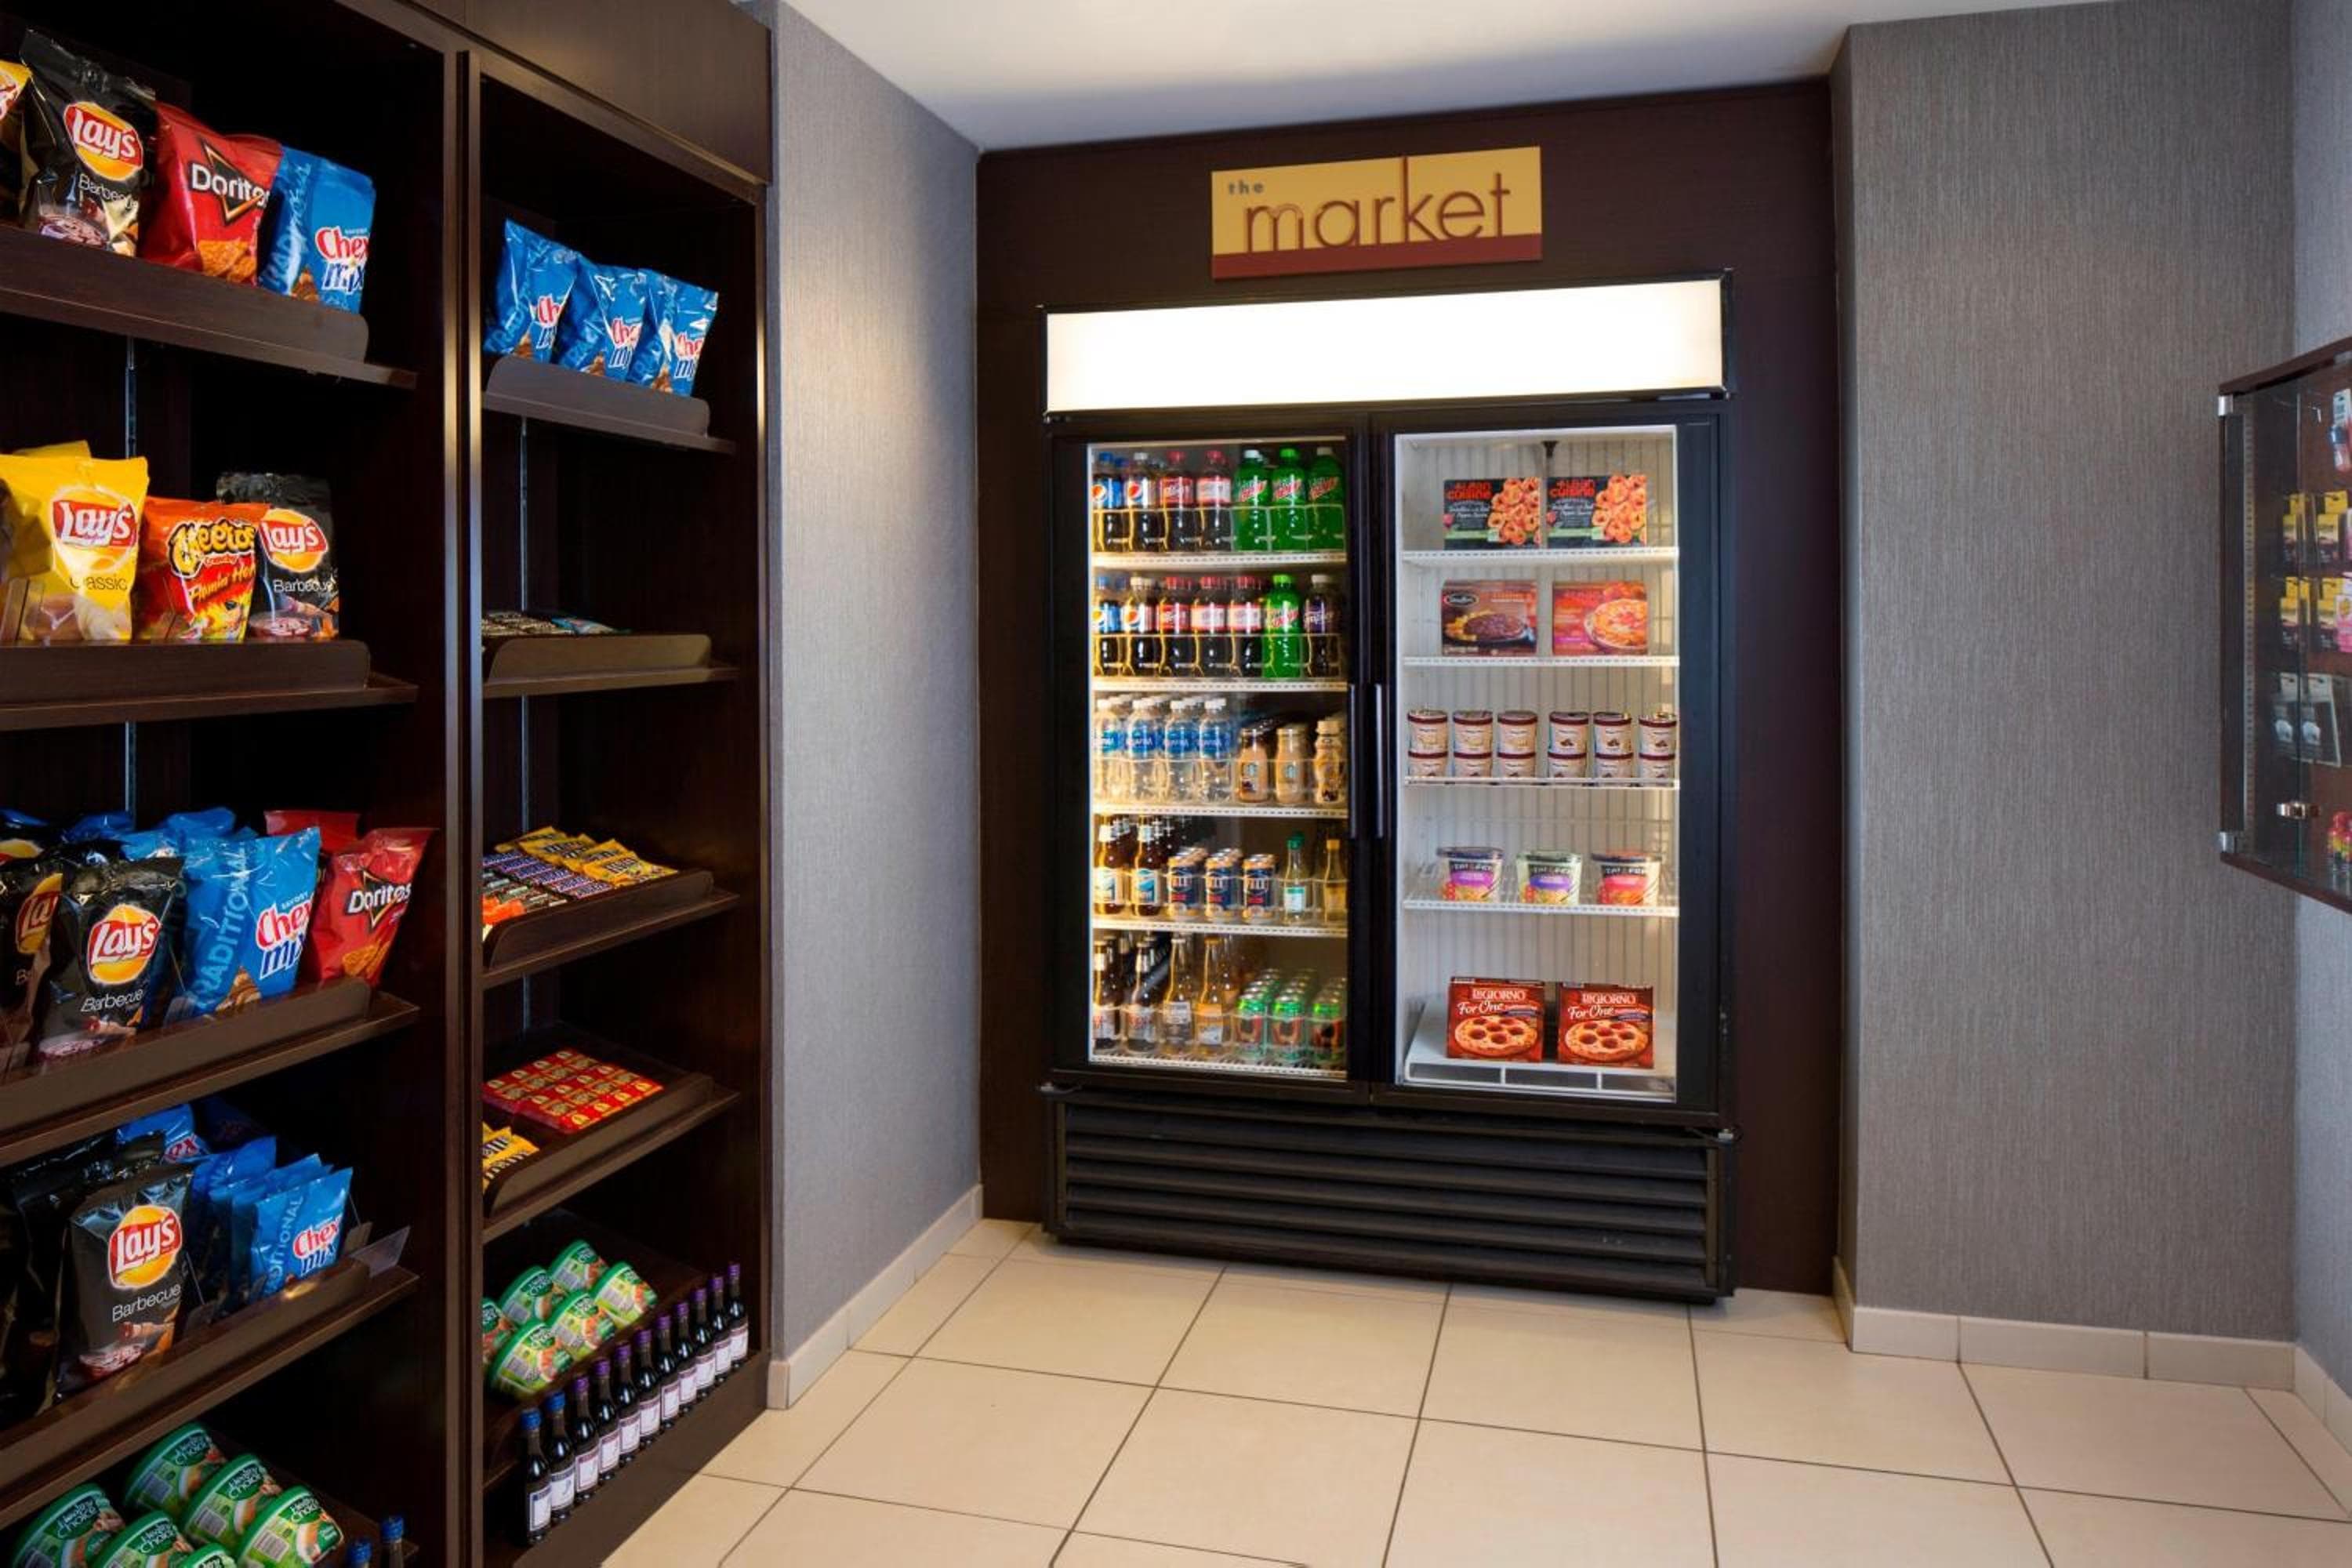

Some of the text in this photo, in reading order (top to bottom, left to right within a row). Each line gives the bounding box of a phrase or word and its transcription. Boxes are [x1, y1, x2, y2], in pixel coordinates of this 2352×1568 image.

[73, 109, 136, 160] Lay's
[1229, 180, 1265, 195] the
[1246, 157, 1511, 253] market
[59, 499, 132, 546] Lay's
[260, 521, 320, 554] Lay's
[70, 574, 128, 591] Cassic
[348, 882, 412, 913] Doritos
[91, 920, 156, 965] Lay's
[81, 989, 144, 1012] Barbecue
[1457, 1000, 1505, 1015] For One
[1568, 1004, 1615, 1020] For One
[116, 1217, 176, 1274] Lay's
[111, 1283, 182, 1323] Barbecue
